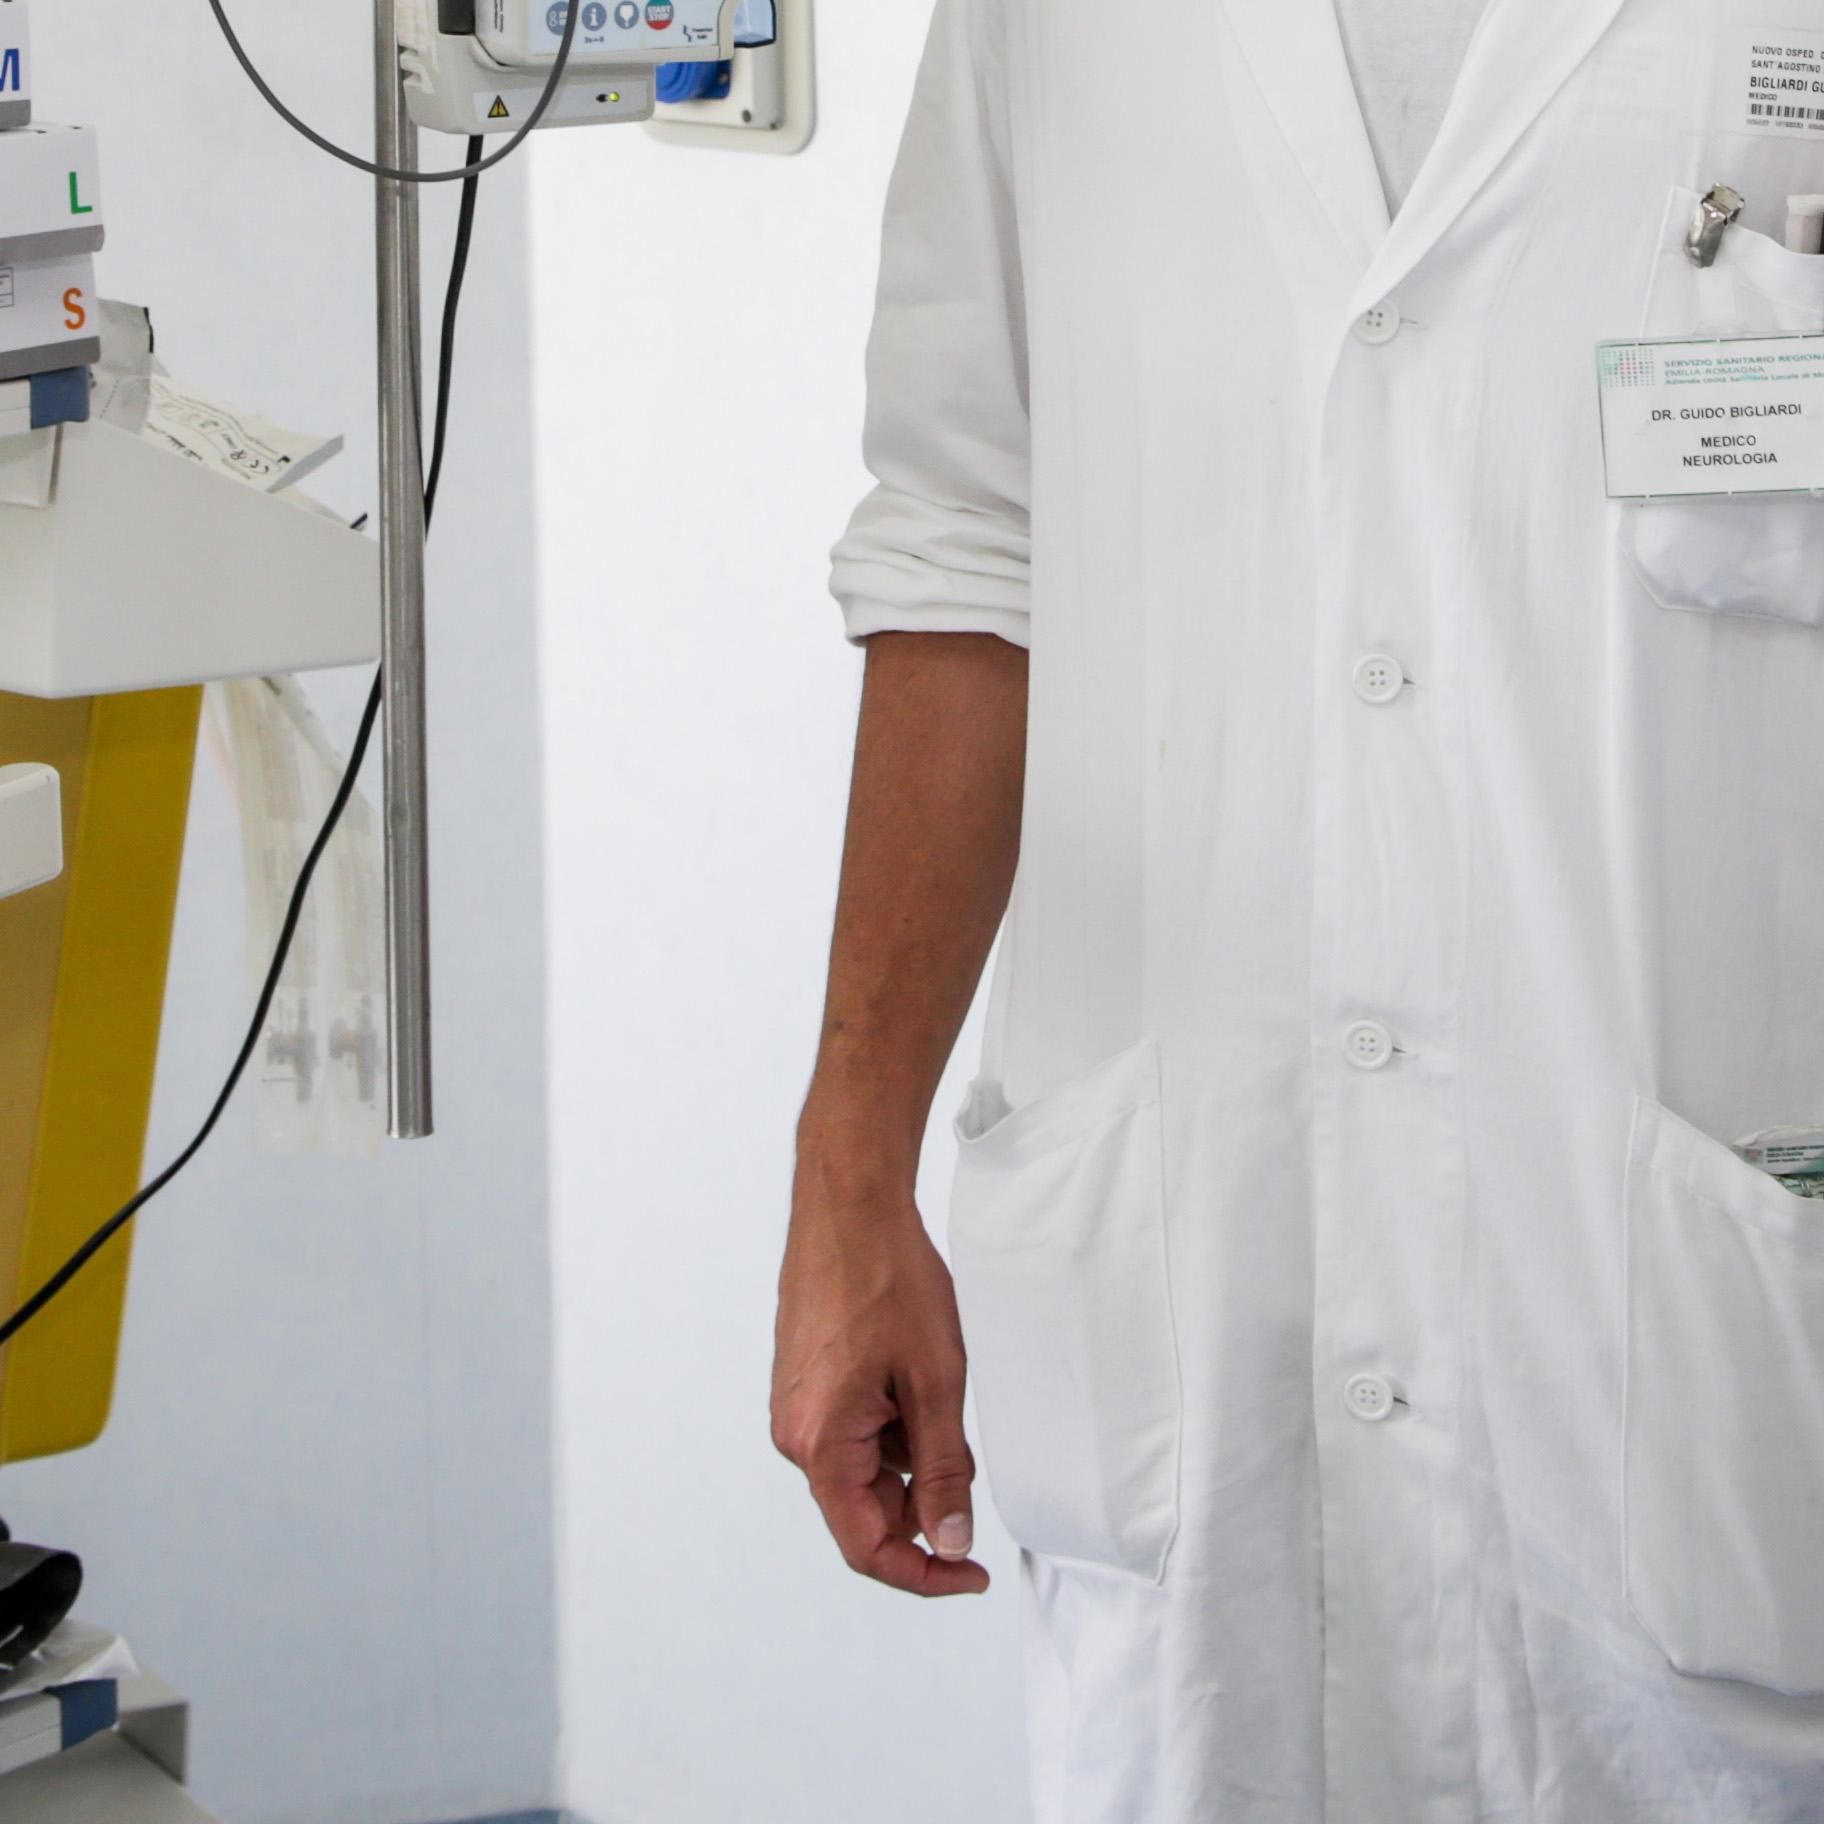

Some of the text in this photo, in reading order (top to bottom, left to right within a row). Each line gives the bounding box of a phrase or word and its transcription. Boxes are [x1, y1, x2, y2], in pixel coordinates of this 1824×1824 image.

[1751, 45, 1783, 56] NUOVO
[1750, 76, 1808, 92] BIGLIARDI
[68, 171, 93, 214] L
[63, 287, 87, 331] S
[1664, 358, 1713, 369] SERVIZIO
[1716, 355, 1776, 366] SANITARIO
[1664, 366, 1766, 378] EMILIA-ROMAGNA
[1651, 404, 1802, 422] DR. GUIDO BIGLIARDI
[1700, 434, 1757, 448] MEDICO
[1682, 452, 1778, 467] NEUROLOGIA
